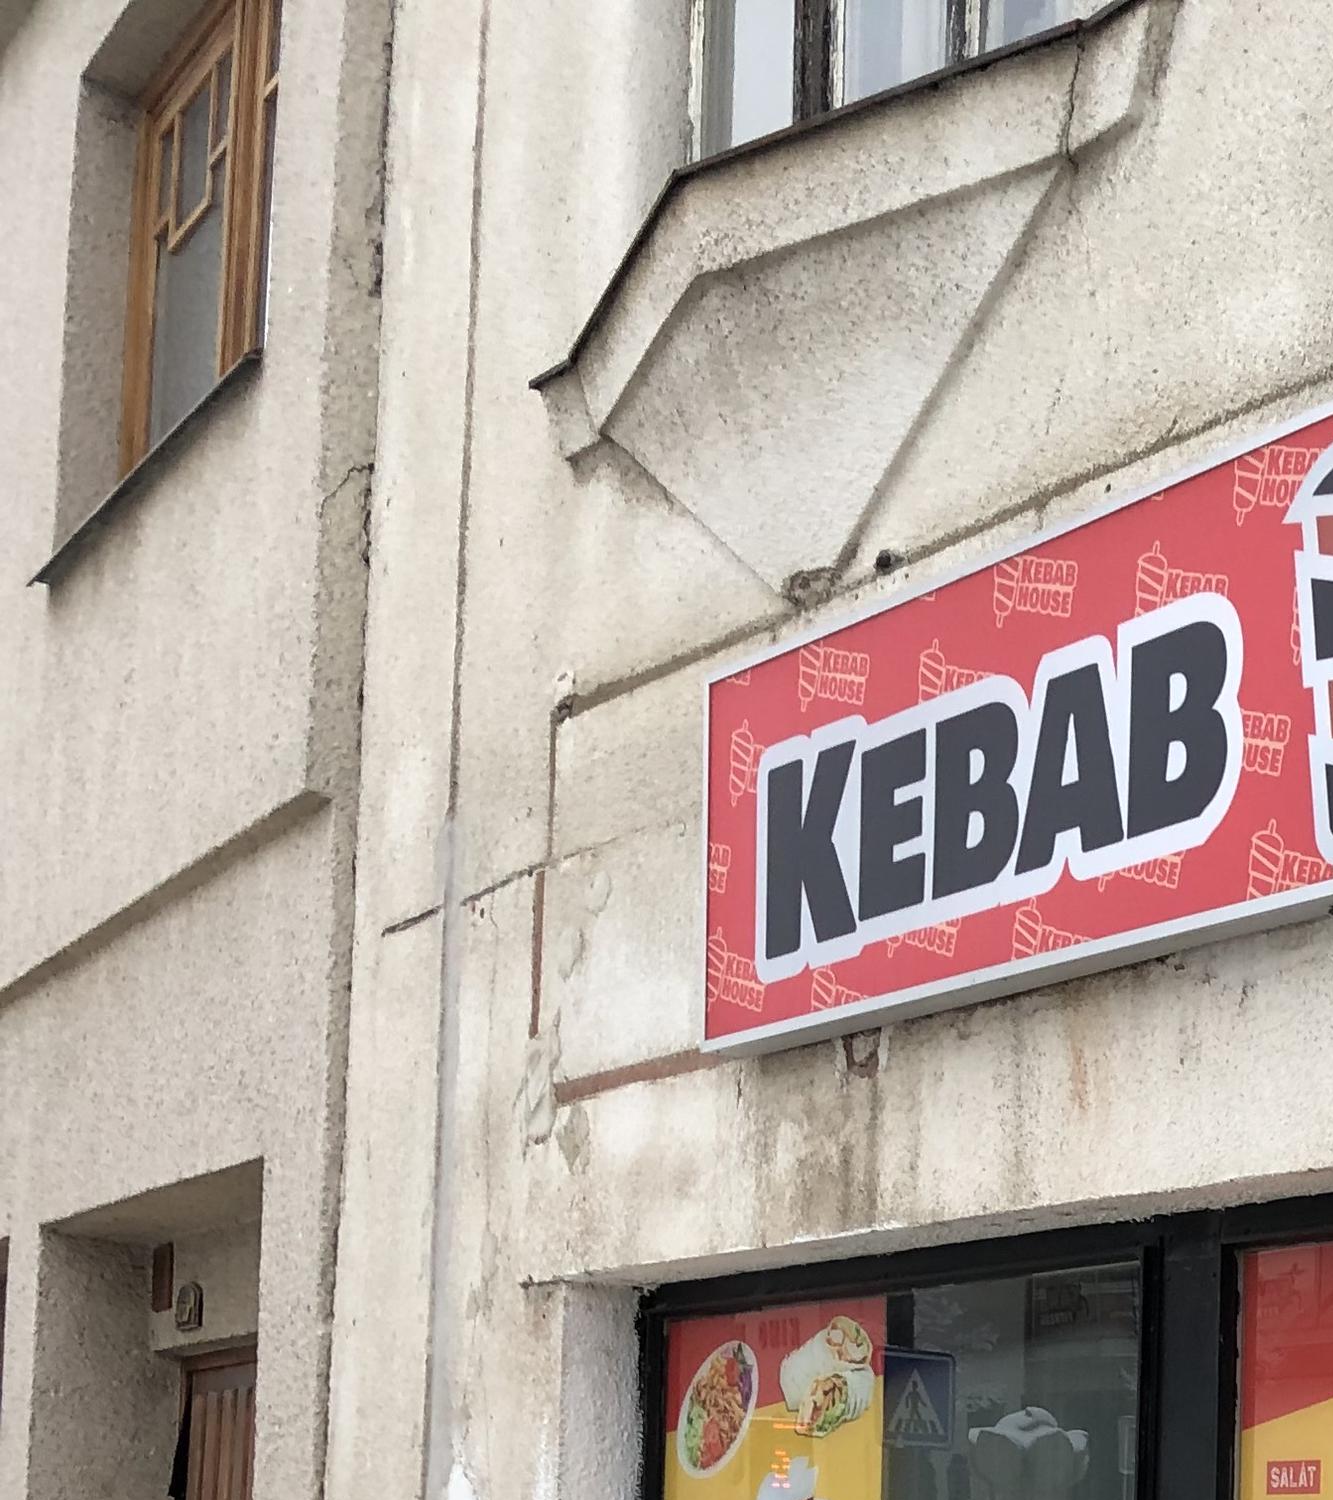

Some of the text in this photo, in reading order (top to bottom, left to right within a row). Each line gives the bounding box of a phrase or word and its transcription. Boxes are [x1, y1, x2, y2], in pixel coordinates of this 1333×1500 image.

[1018, 556, 1078, 587] KEBAB
[1015, 584, 1075, 617] HOUSE
[821, 648, 870, 679] KEBAB
[818, 673, 866, 705] HOUSE
[762, 618, 1232, 964] KEBAB
[722, 976, 765, 1012] HOUSE
[1269, 1461, 1317, 1489] SALÁT
